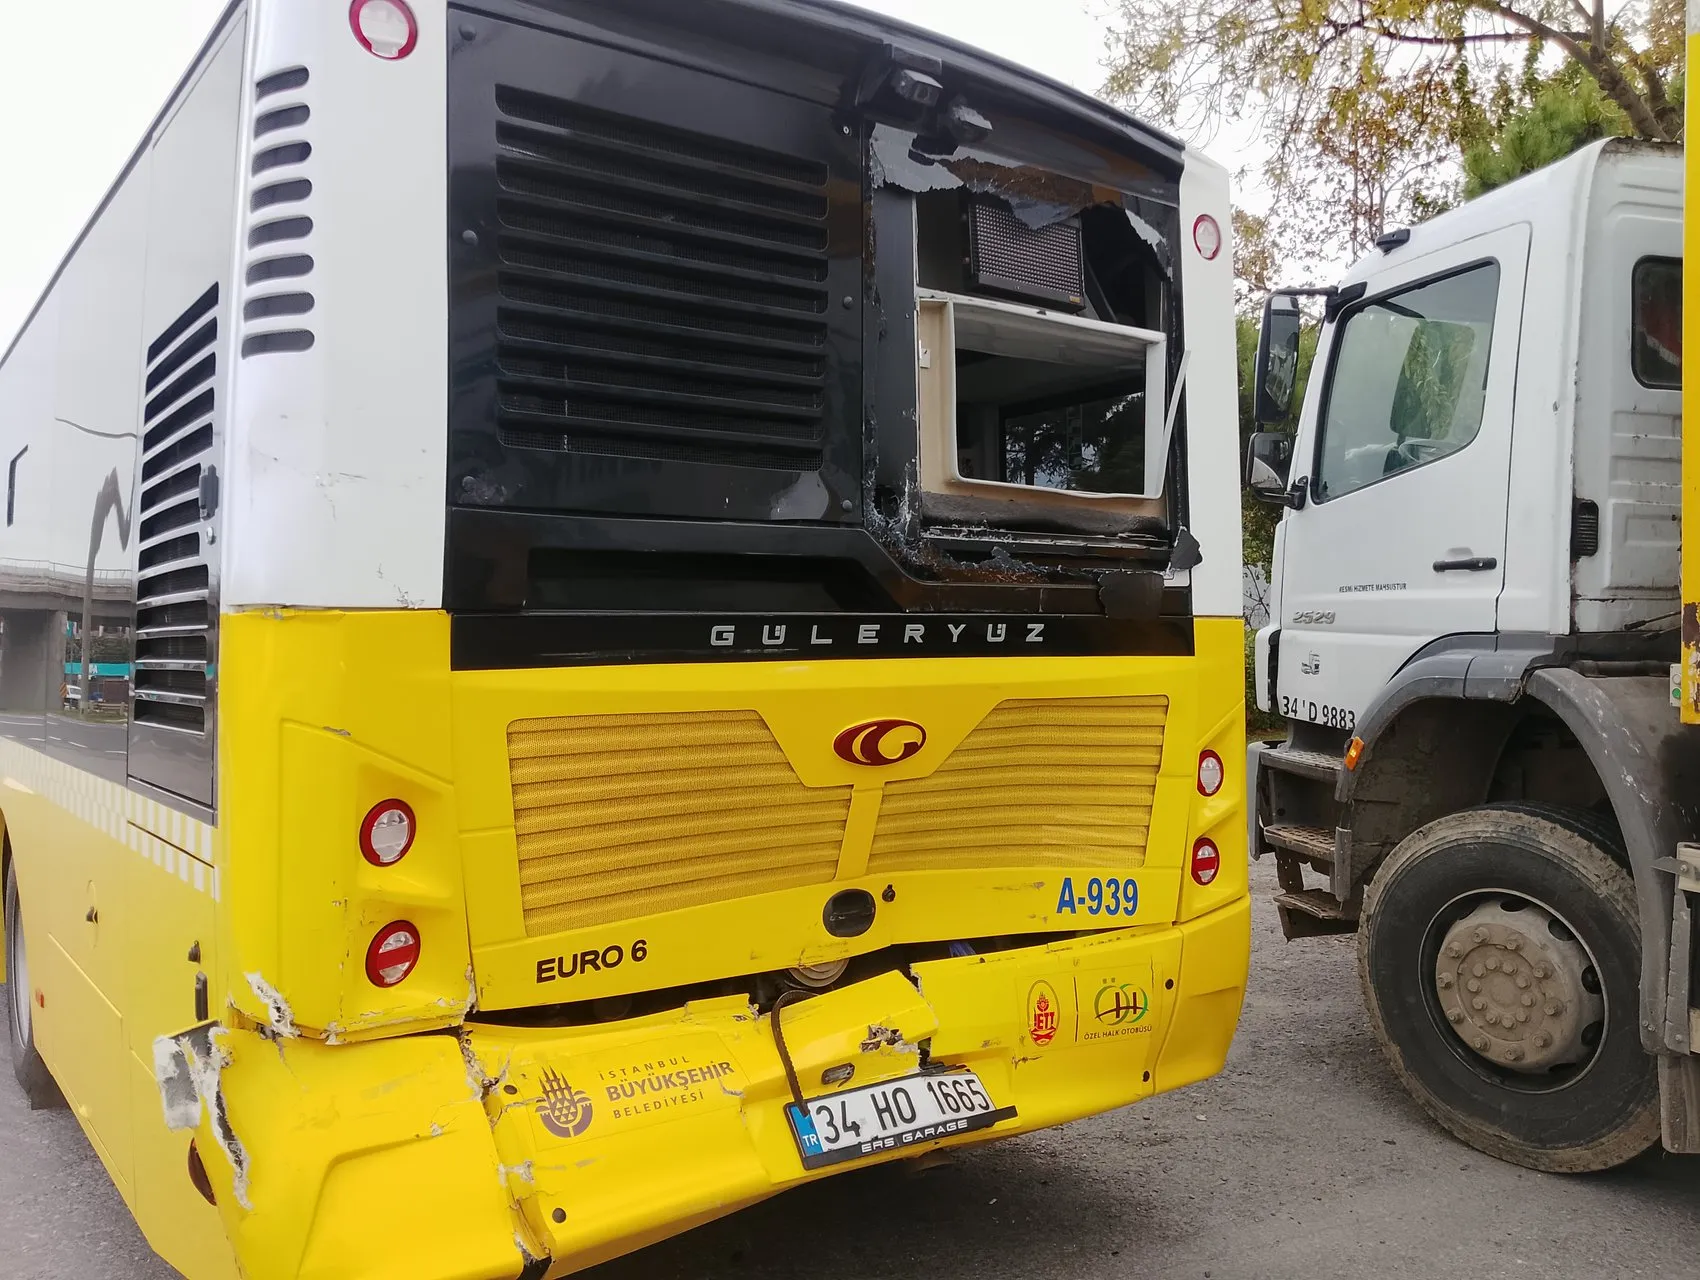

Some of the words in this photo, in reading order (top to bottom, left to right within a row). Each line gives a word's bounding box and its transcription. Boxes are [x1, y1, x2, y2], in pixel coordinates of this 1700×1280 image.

[1293, 610, 1336, 624] 2529
[710, 623, 1045, 646] GÜLERYÜZ
[1282, 695, 1298, 717] 34
[1322, 704, 1356, 730] 9883
[1056, 876, 1139, 917] A-939
[536, 945, 624, 984] EURO
[631, 939, 648, 963] 6
[1102, 1030, 1120, 1038] HALK
[599, 1055, 690, 1081] İSTANBUL
[605, 1060, 735, 1102] BÜYÜKŞEHİR
[613, 1089, 704, 1119] BELEDİYESİ
[802, 1134, 818, 1147] TR
[815, 1100, 861, 1144] 34
[870, 1087, 917, 1131] HO
[926, 1078, 990, 1115] 1665
[861, 1137, 895, 1153] ERS
[902, 1119, 968, 1143] GARAGE
